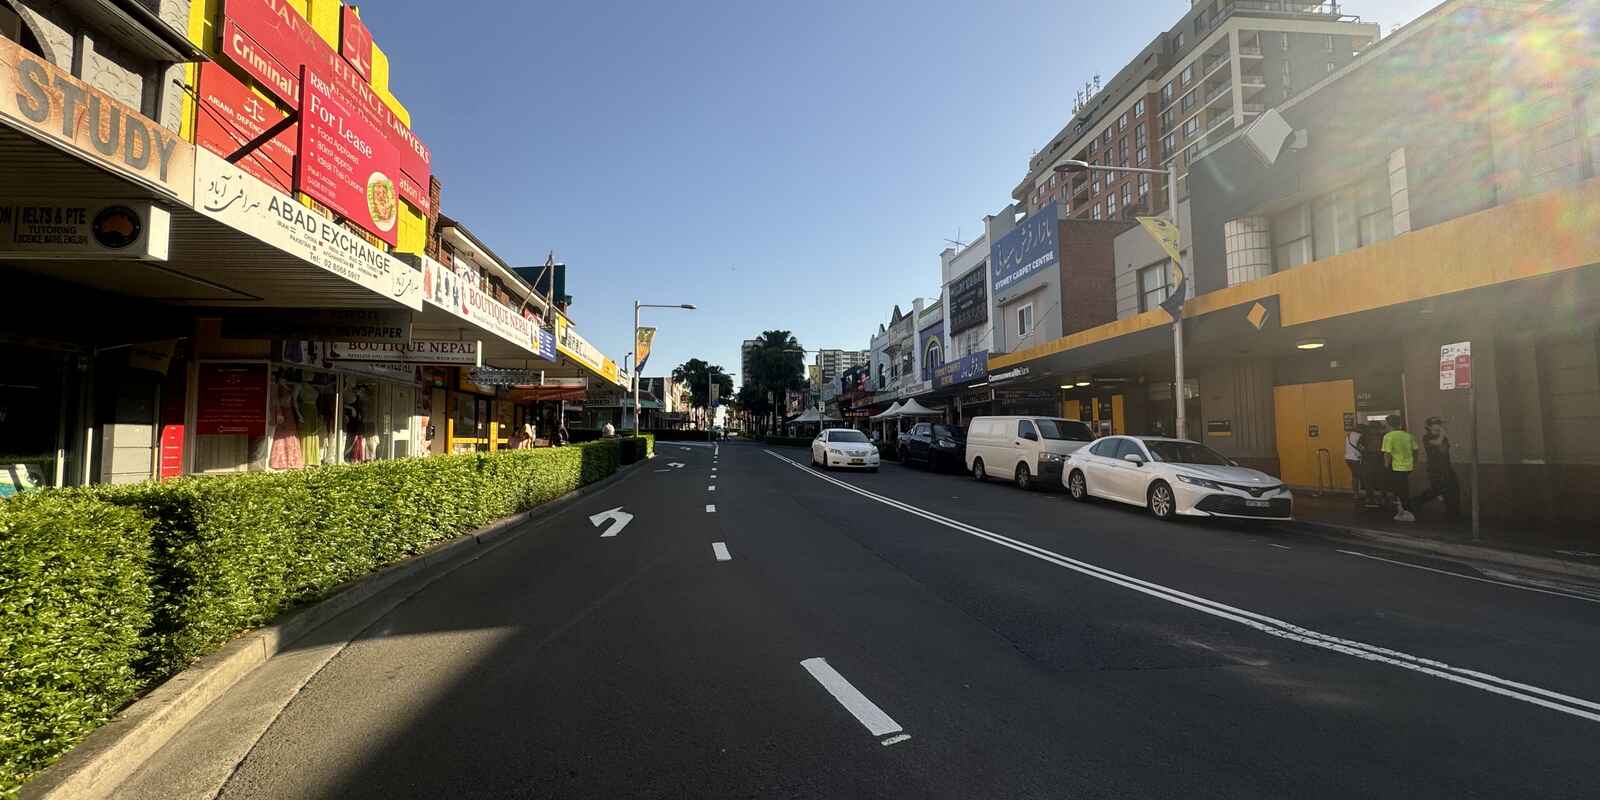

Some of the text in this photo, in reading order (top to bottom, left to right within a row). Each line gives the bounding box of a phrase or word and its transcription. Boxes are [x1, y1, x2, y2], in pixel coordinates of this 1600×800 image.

[232, 33, 293, 98] Criminal
[15, 58, 177, 183] STUDY
[310, 94, 336, 128] For
[338, 116, 372, 160] Lease
[386, 109, 430, 164] LAWYERS
[22, 207, 52, 224] IELTS
[66, 208, 87, 224] PTE
[28, 226, 77, 235] TUTORING
[268, 195, 317, 234] ABAD
[321, 222, 391, 274] EXCHANGE
[308, 251, 321, 264] Tel:
[323, 259, 332, 268] 02
[995, 273, 1013, 290] SYDNEY
[1012, 263, 1032, 280] CARPET
[1032, 250, 1054, 270] CENTRE
[469, 287, 510, 326] BOUTIQUE
[509, 310, 531, 337] NEPAL
[348, 341, 476, 355] BOUTIQUE NEPAL
